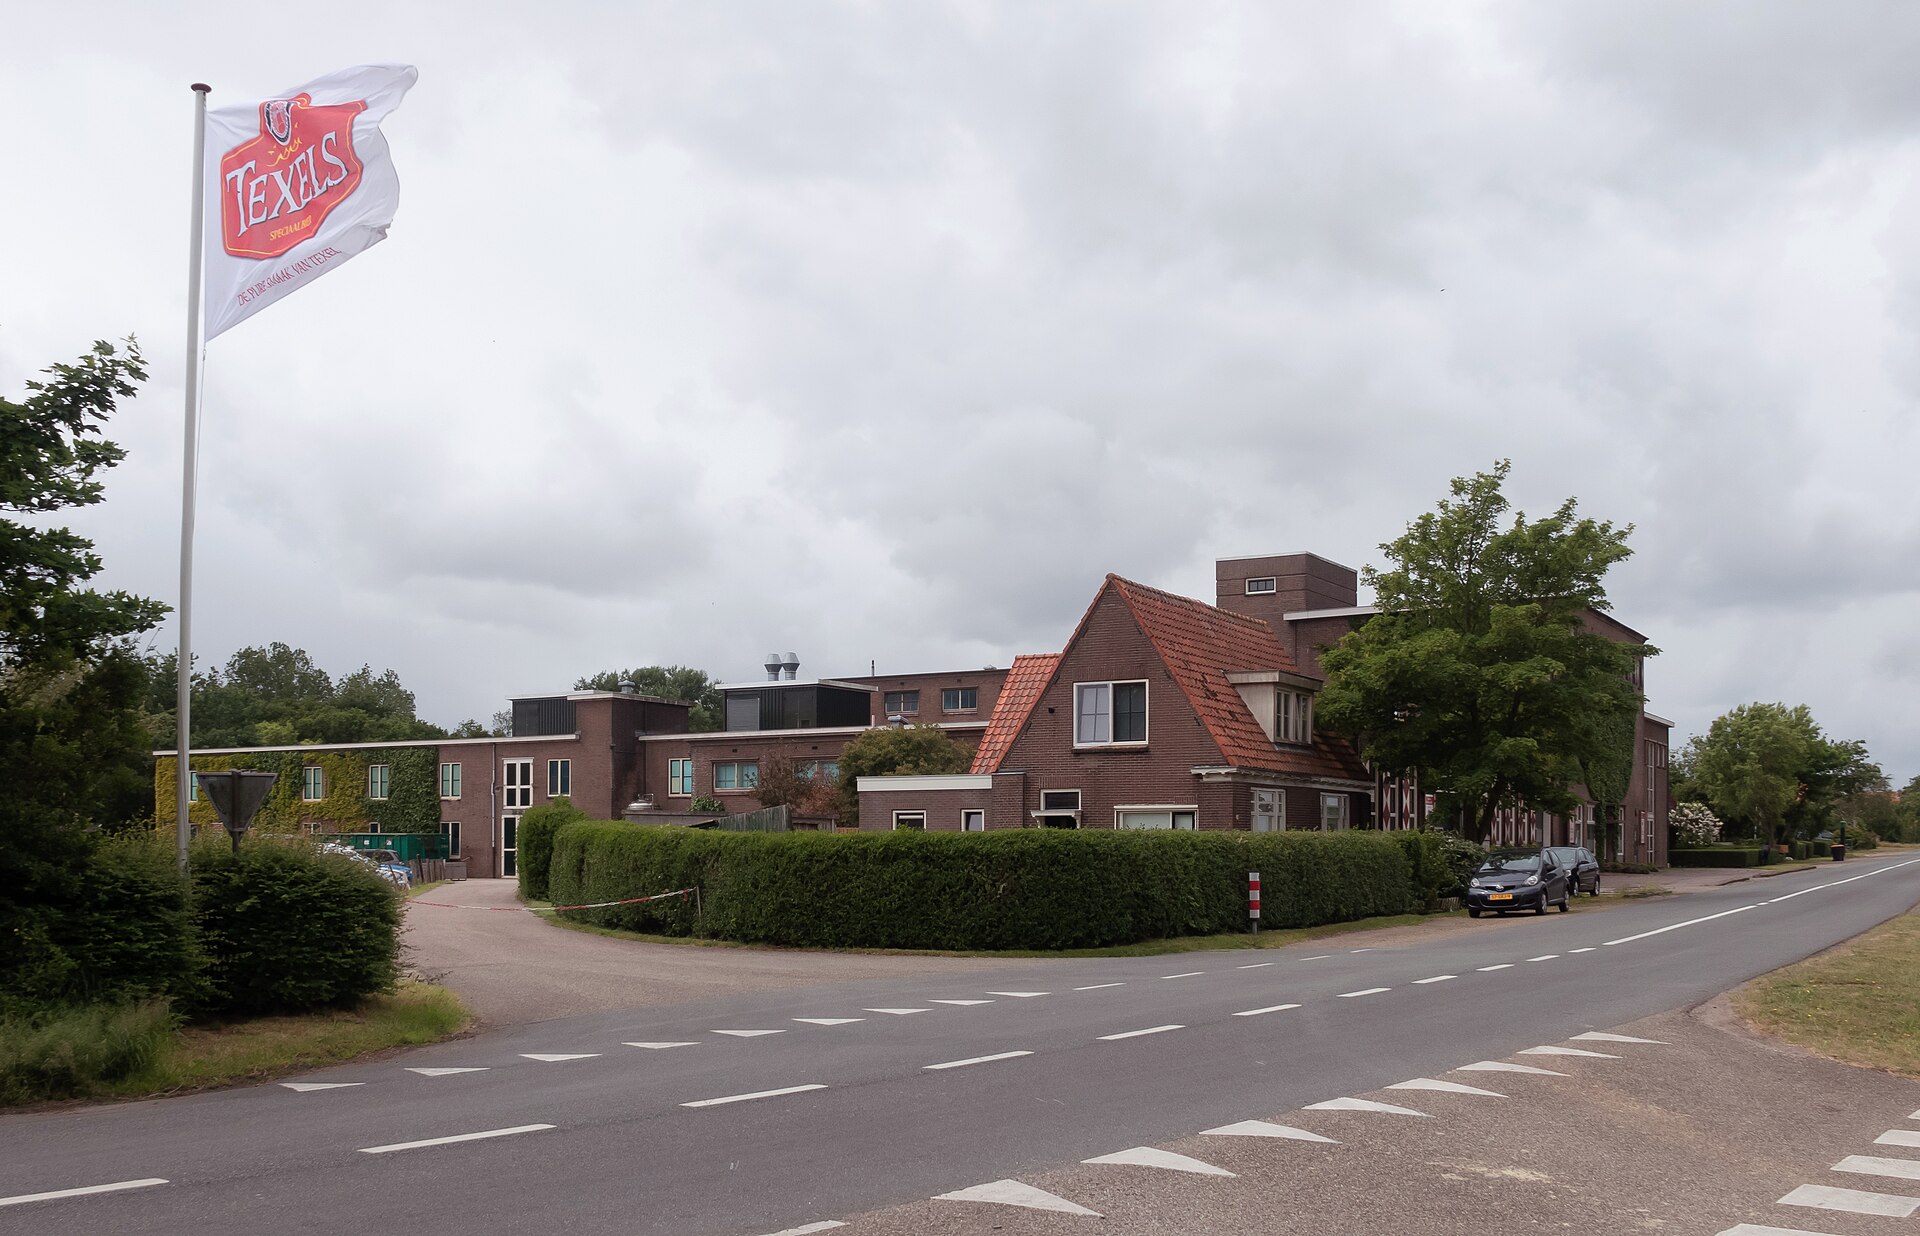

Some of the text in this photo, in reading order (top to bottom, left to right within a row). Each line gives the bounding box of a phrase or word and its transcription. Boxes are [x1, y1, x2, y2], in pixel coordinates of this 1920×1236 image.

[226, 131, 349, 237] TEXELS
[237, 291, 251, 306] DE
[291, 258, 313, 275] VAN
[309, 247, 342, 266] TEXEL
